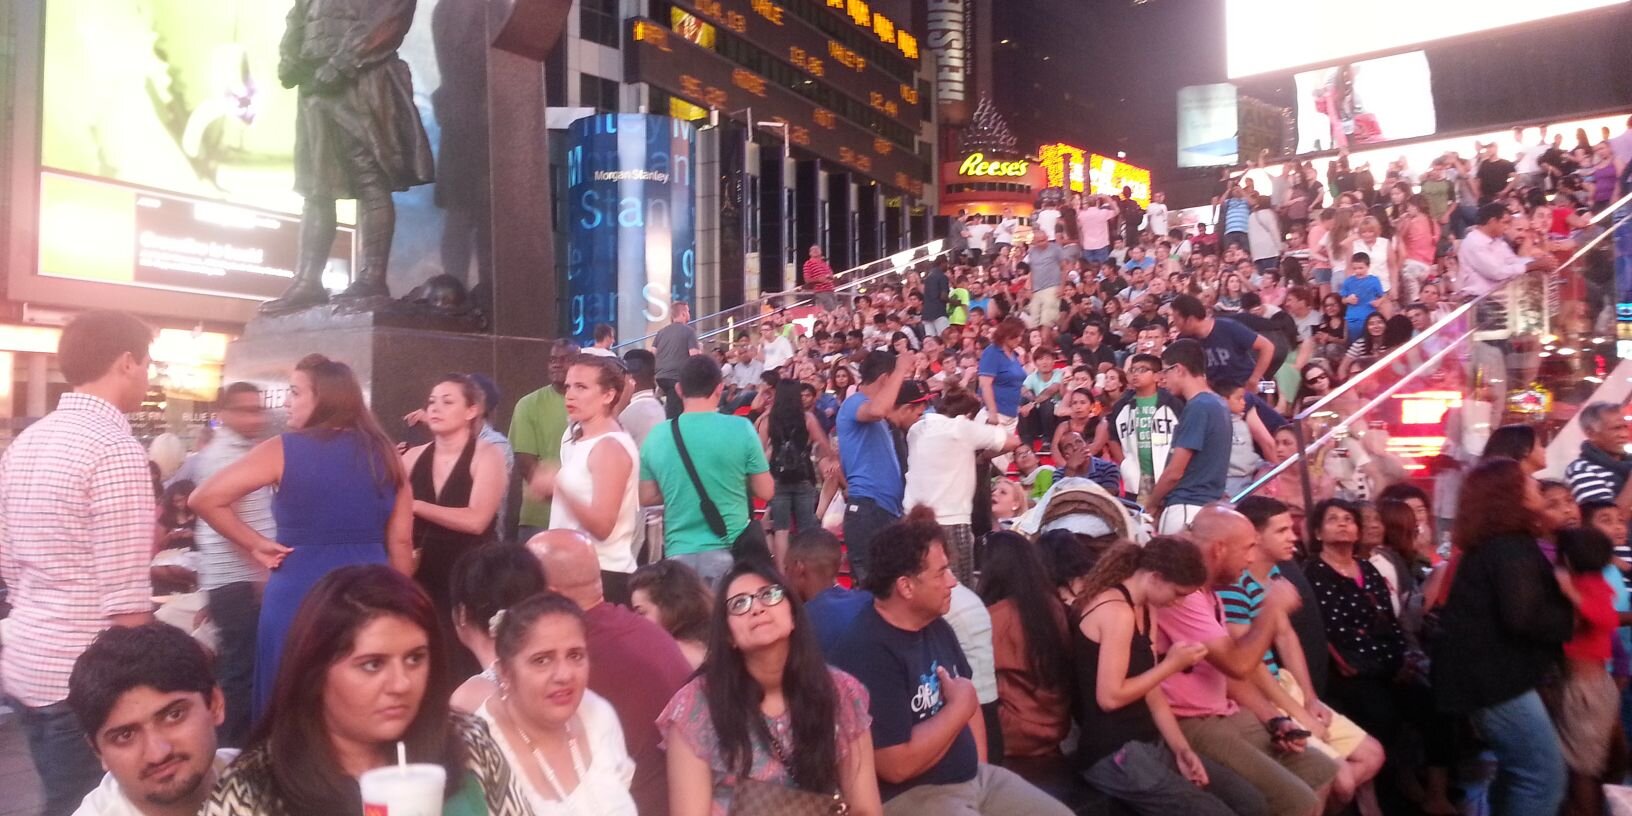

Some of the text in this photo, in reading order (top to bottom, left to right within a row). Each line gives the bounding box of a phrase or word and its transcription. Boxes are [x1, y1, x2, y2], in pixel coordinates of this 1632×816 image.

[959, 152, 1029, 176] Reese's
[594, 169, 670, 184] Morgan Stanley
[1205, 346, 1231, 368] AP
